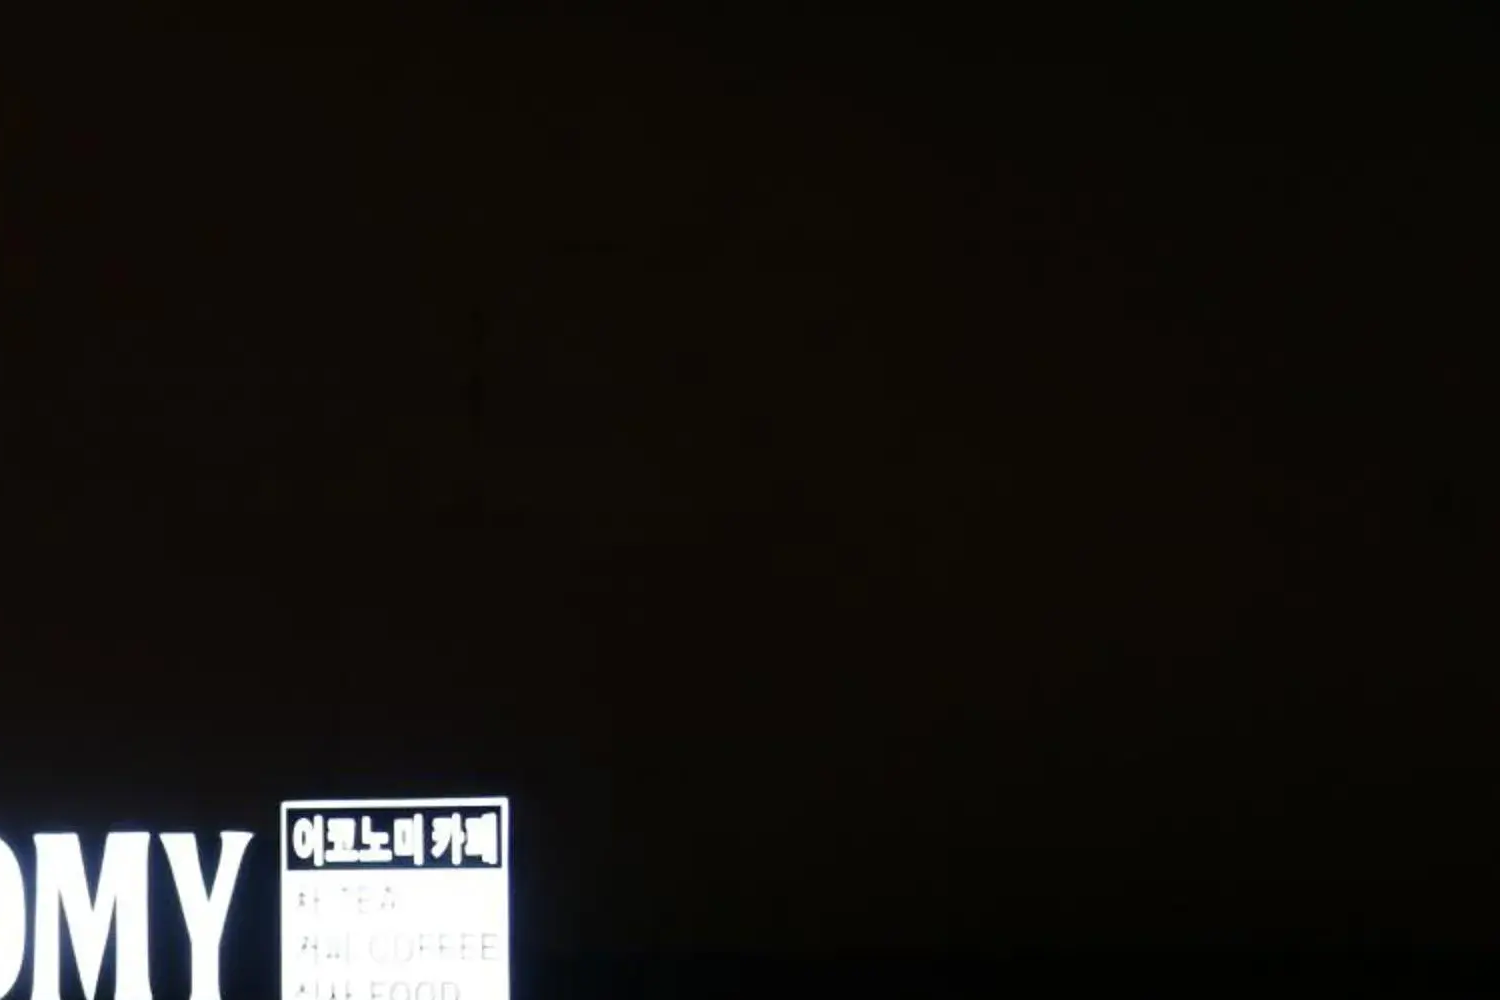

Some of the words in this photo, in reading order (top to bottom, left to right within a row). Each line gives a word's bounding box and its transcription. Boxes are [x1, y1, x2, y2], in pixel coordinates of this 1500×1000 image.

[292, 811, 425, 867] 이코노미
[431, 811, 498, 866] 카페
[368, 931, 499, 966] COFFEE
